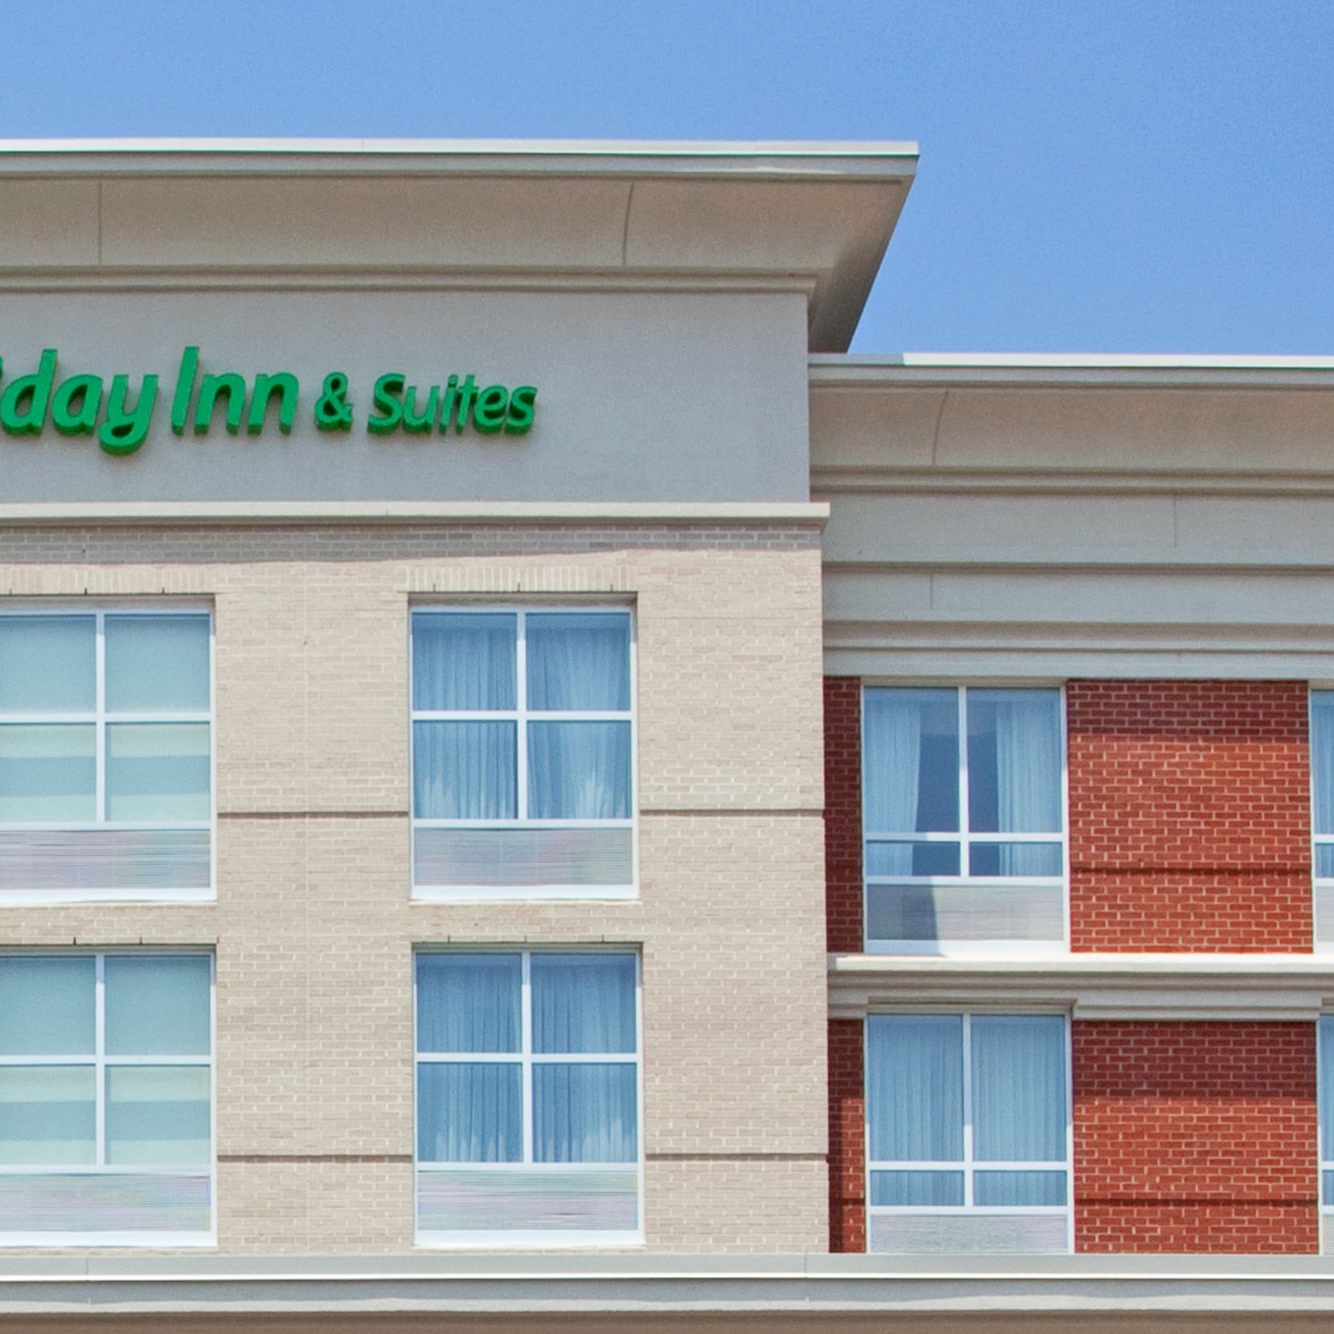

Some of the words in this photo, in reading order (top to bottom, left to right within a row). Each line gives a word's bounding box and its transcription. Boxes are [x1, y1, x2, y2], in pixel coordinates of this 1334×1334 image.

[170, 346, 300, 436] Inn
[315, 371, 354, 432] &
[367, 372, 538, 435] Suites
